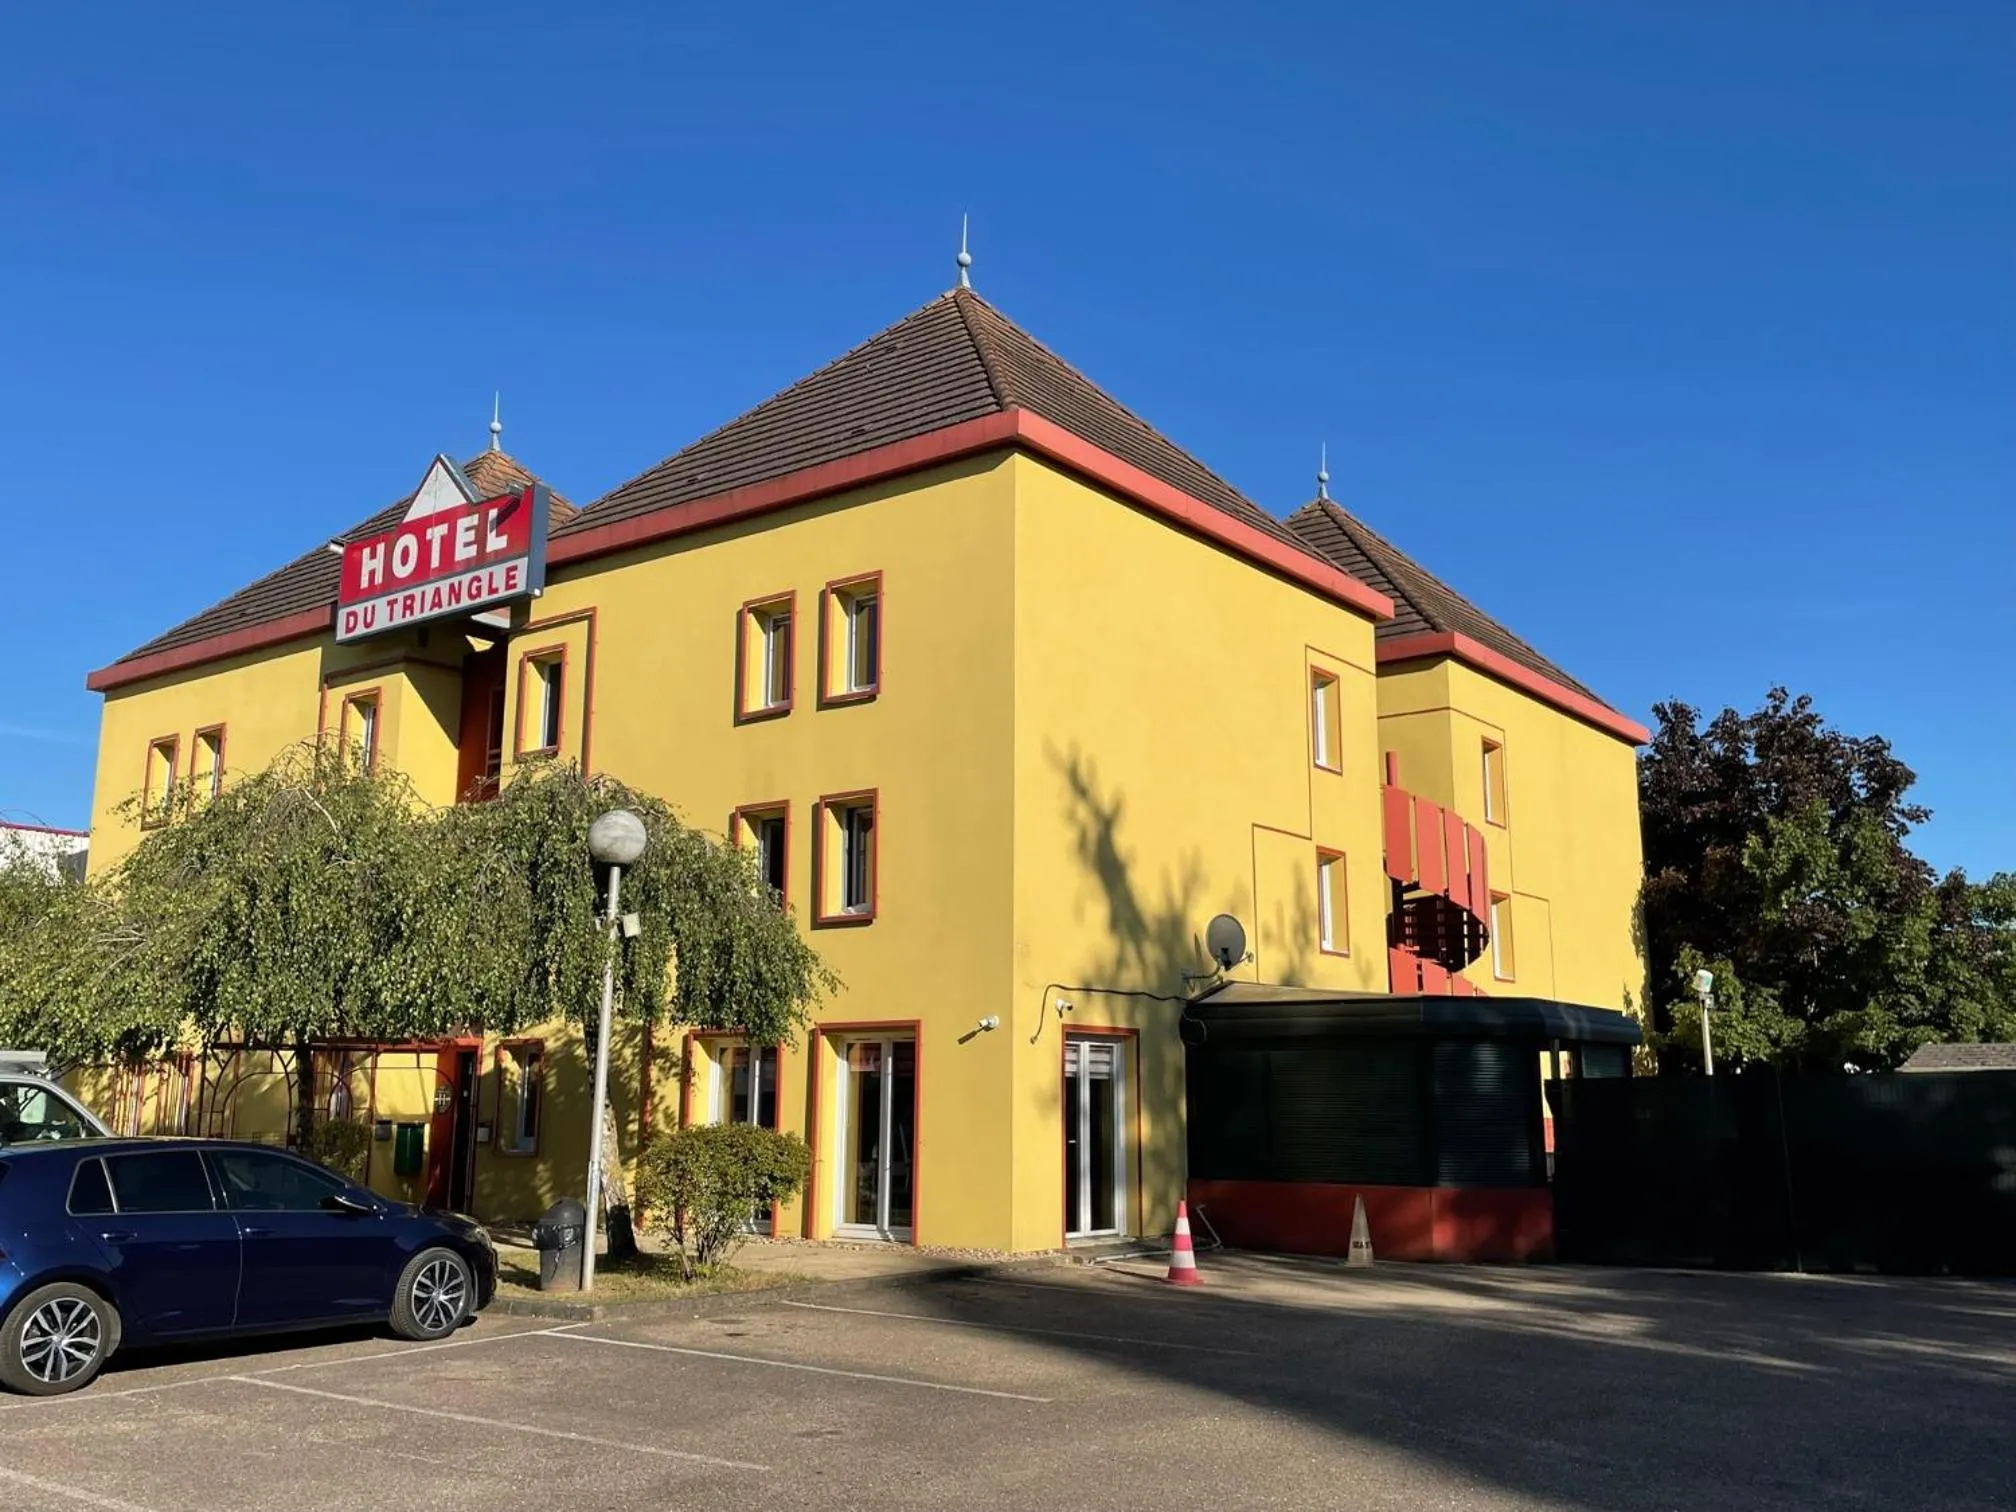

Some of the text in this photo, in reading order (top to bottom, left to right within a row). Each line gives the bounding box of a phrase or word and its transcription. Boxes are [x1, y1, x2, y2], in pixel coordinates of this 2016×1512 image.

[360, 508, 508, 589] HOTEL
[344, 565, 518, 634] DU TRIANGLE
